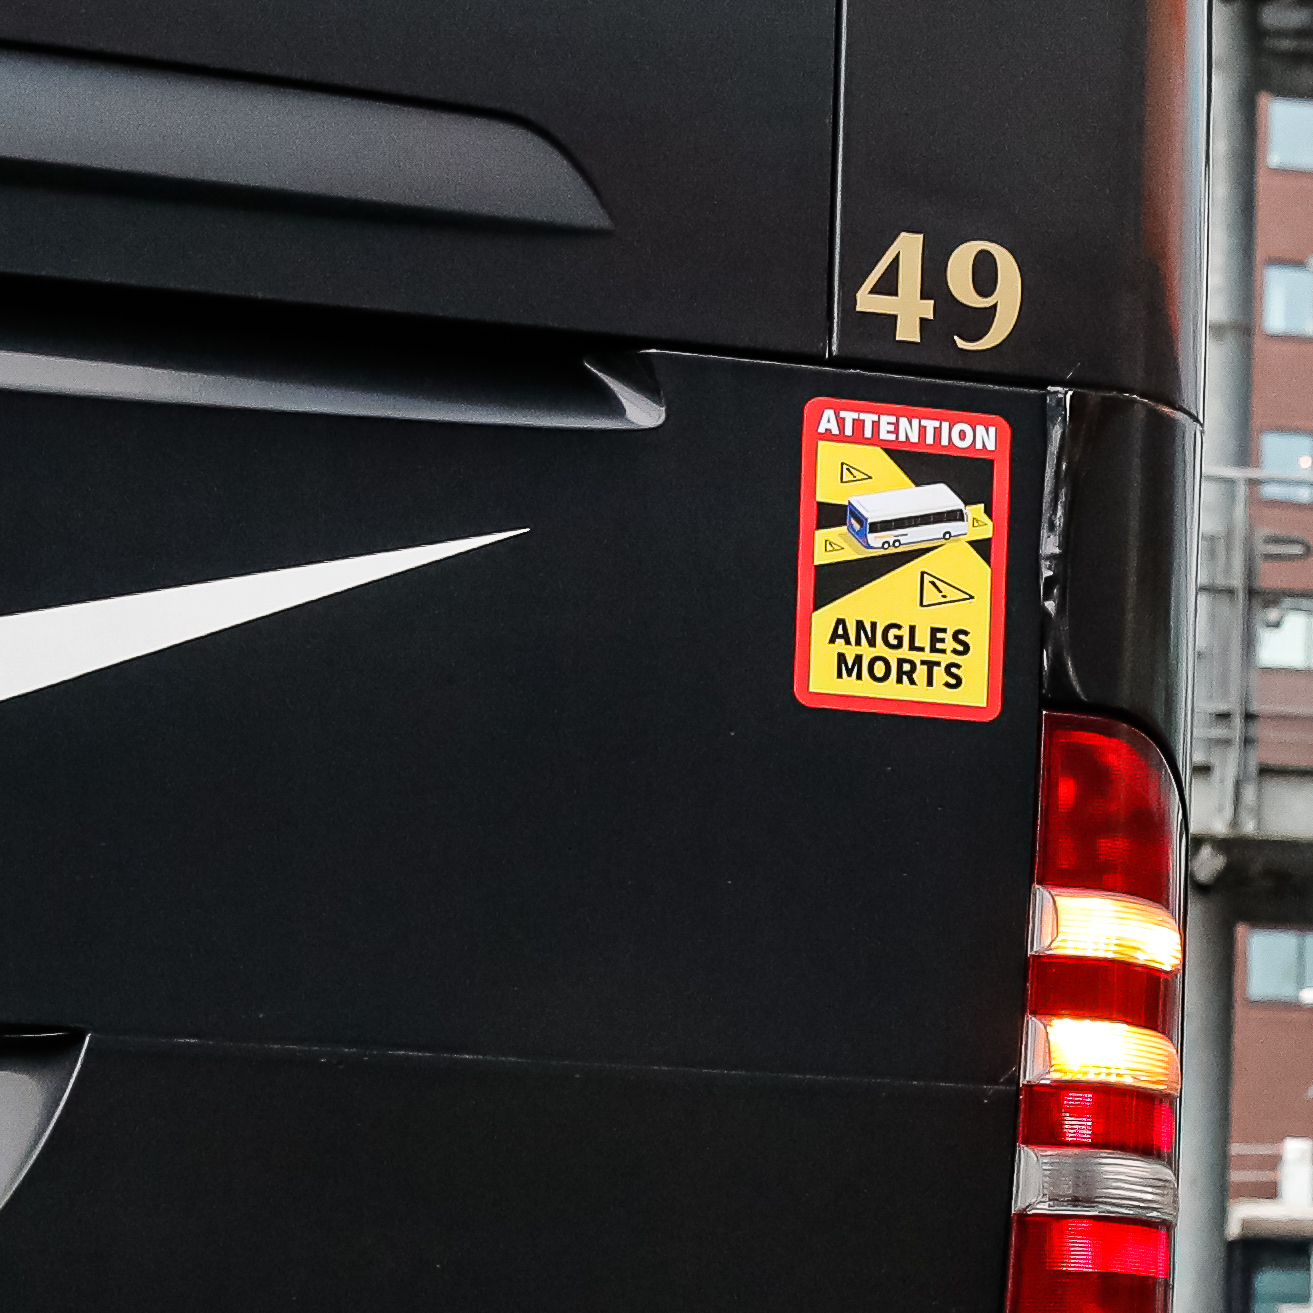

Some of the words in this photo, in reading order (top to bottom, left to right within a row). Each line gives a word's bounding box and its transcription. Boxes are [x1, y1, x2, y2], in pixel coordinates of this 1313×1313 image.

[856, 231, 1022, 350] 49
[817, 409, 997, 451] ATTENTION
[828, 617, 971, 656] ANGLES
[836, 652, 963, 689] MORTS
